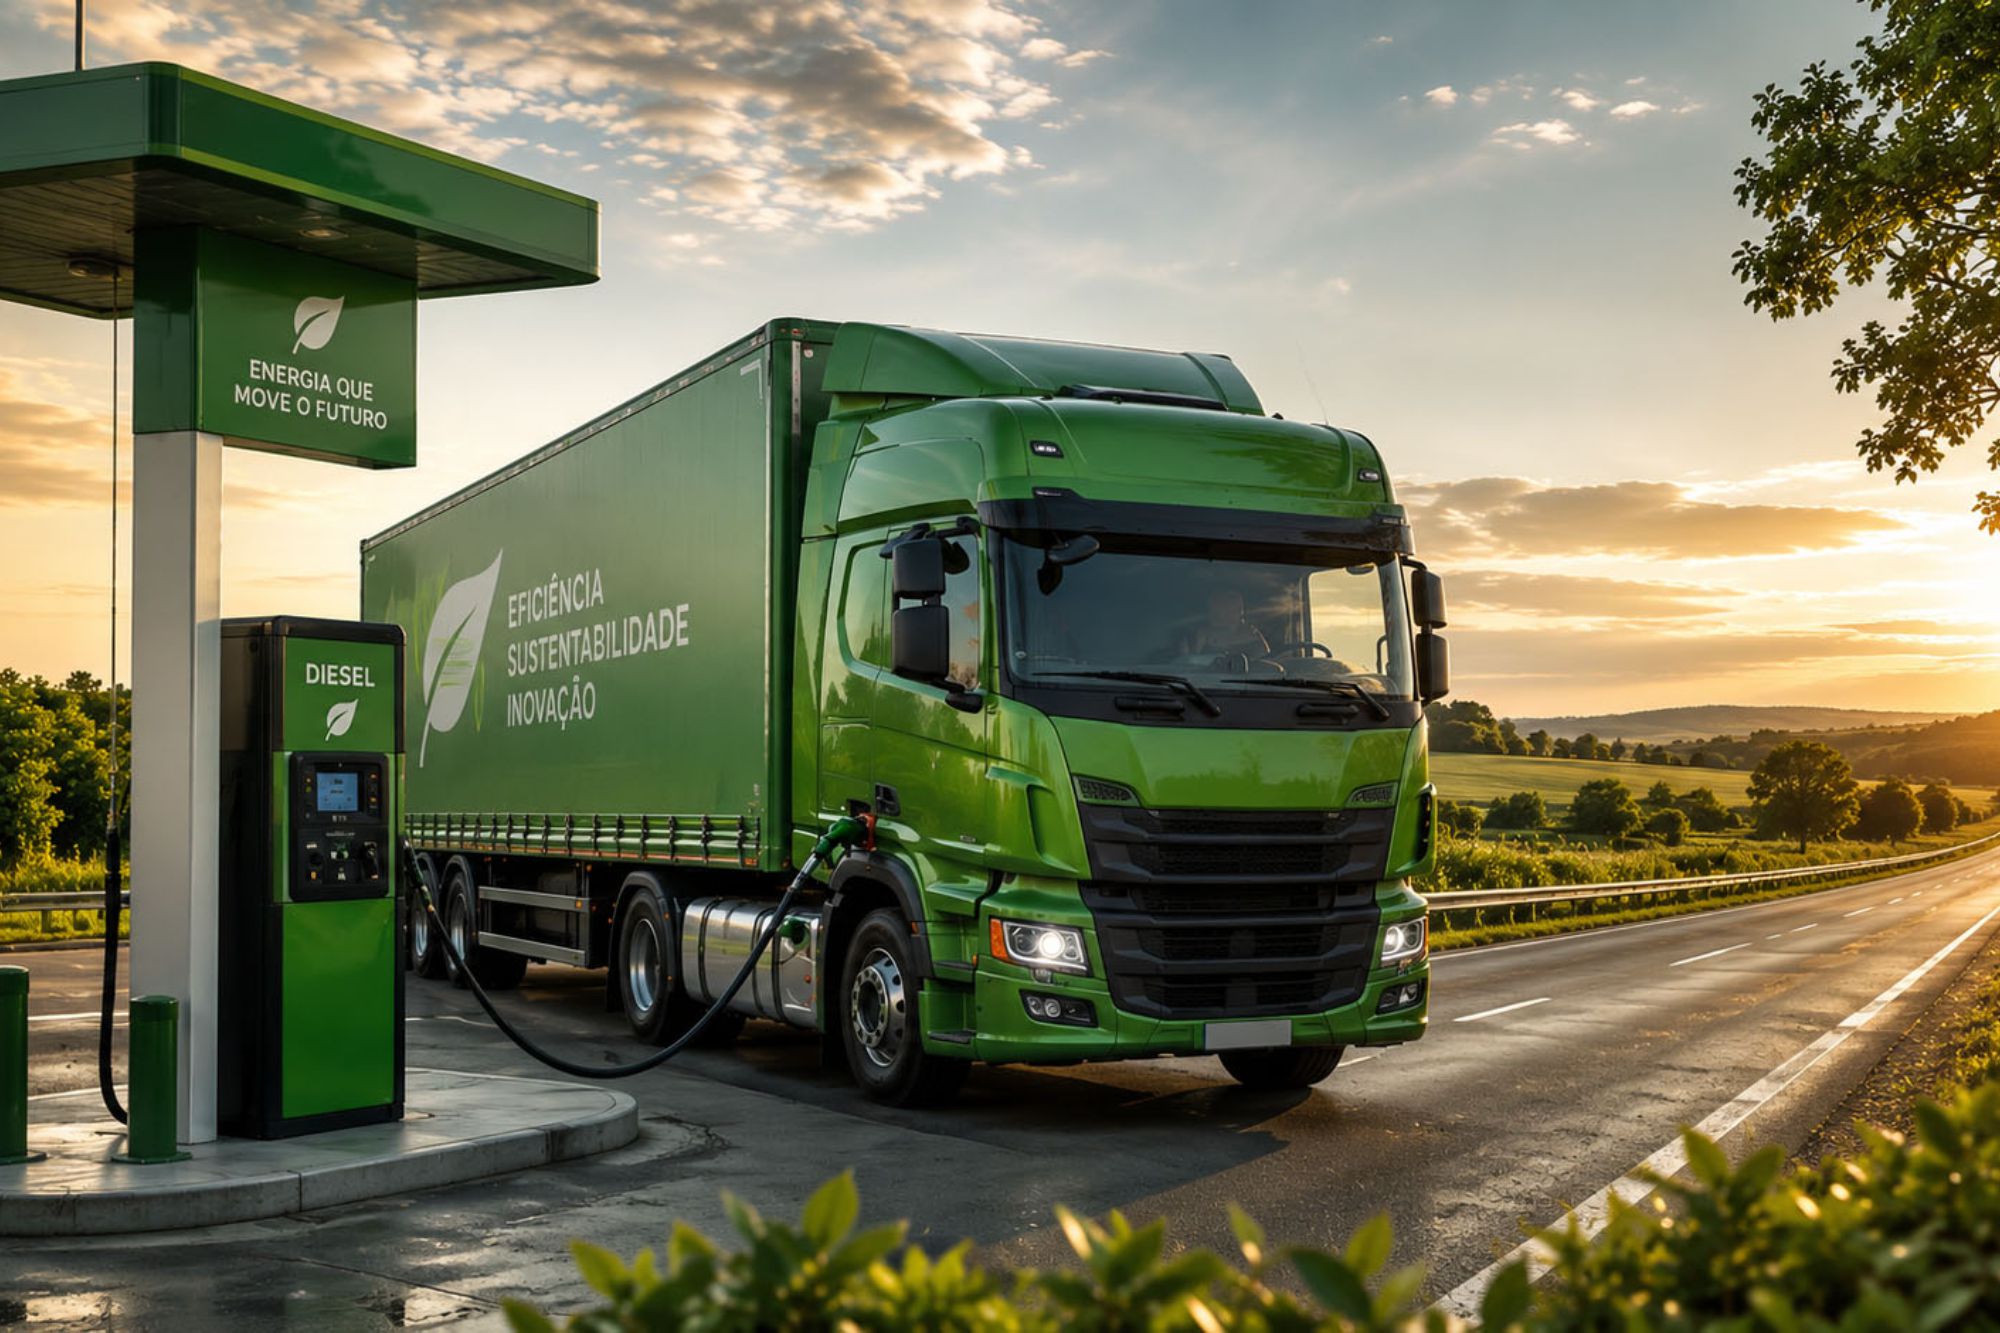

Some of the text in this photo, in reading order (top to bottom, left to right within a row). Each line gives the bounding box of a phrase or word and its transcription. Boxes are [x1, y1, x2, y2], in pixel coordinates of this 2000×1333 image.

[250, 359, 374, 401] ENERGIA QUE
[234, 384, 387, 429] MOVE O FUTURO
[507, 568, 604, 629] EFICIÊNCIA
[507, 604, 690, 677] SUSTENTABILIDADE
[305, 662, 376, 687] DIESEL
